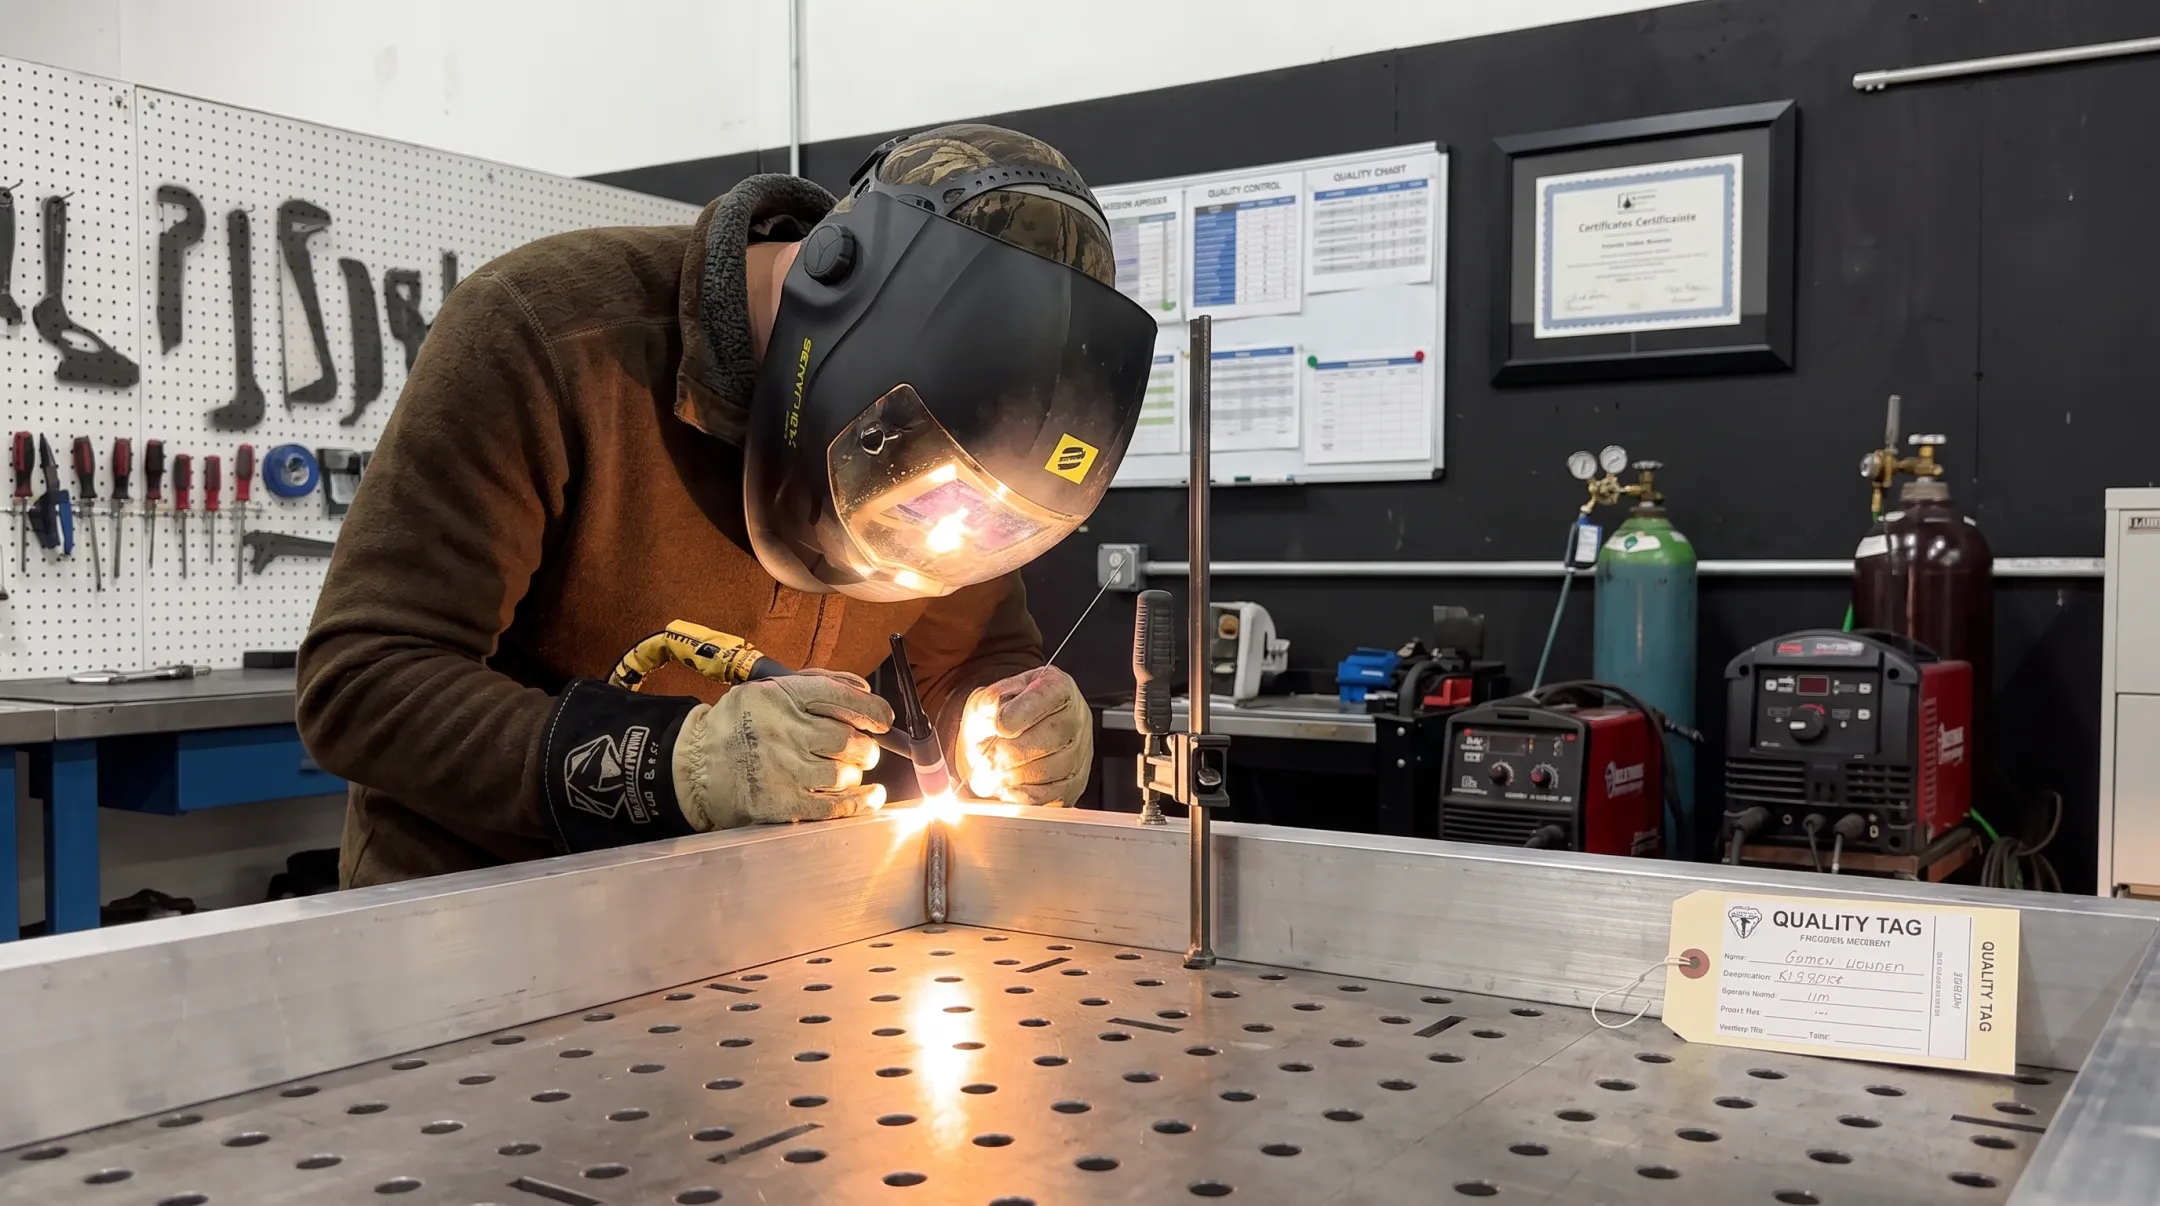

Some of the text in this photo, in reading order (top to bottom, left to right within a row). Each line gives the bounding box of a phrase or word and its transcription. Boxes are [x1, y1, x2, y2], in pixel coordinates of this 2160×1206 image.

[1333, 168, 1372, 182] QUALITY
[1208, 181, 1282, 199] QUALITY CONTROL
[1772, 910, 1870, 933] QUALITY
[1876, 916, 1922, 936] TAG
[1979, 941, 1995, 1032] QUALITY TAG
